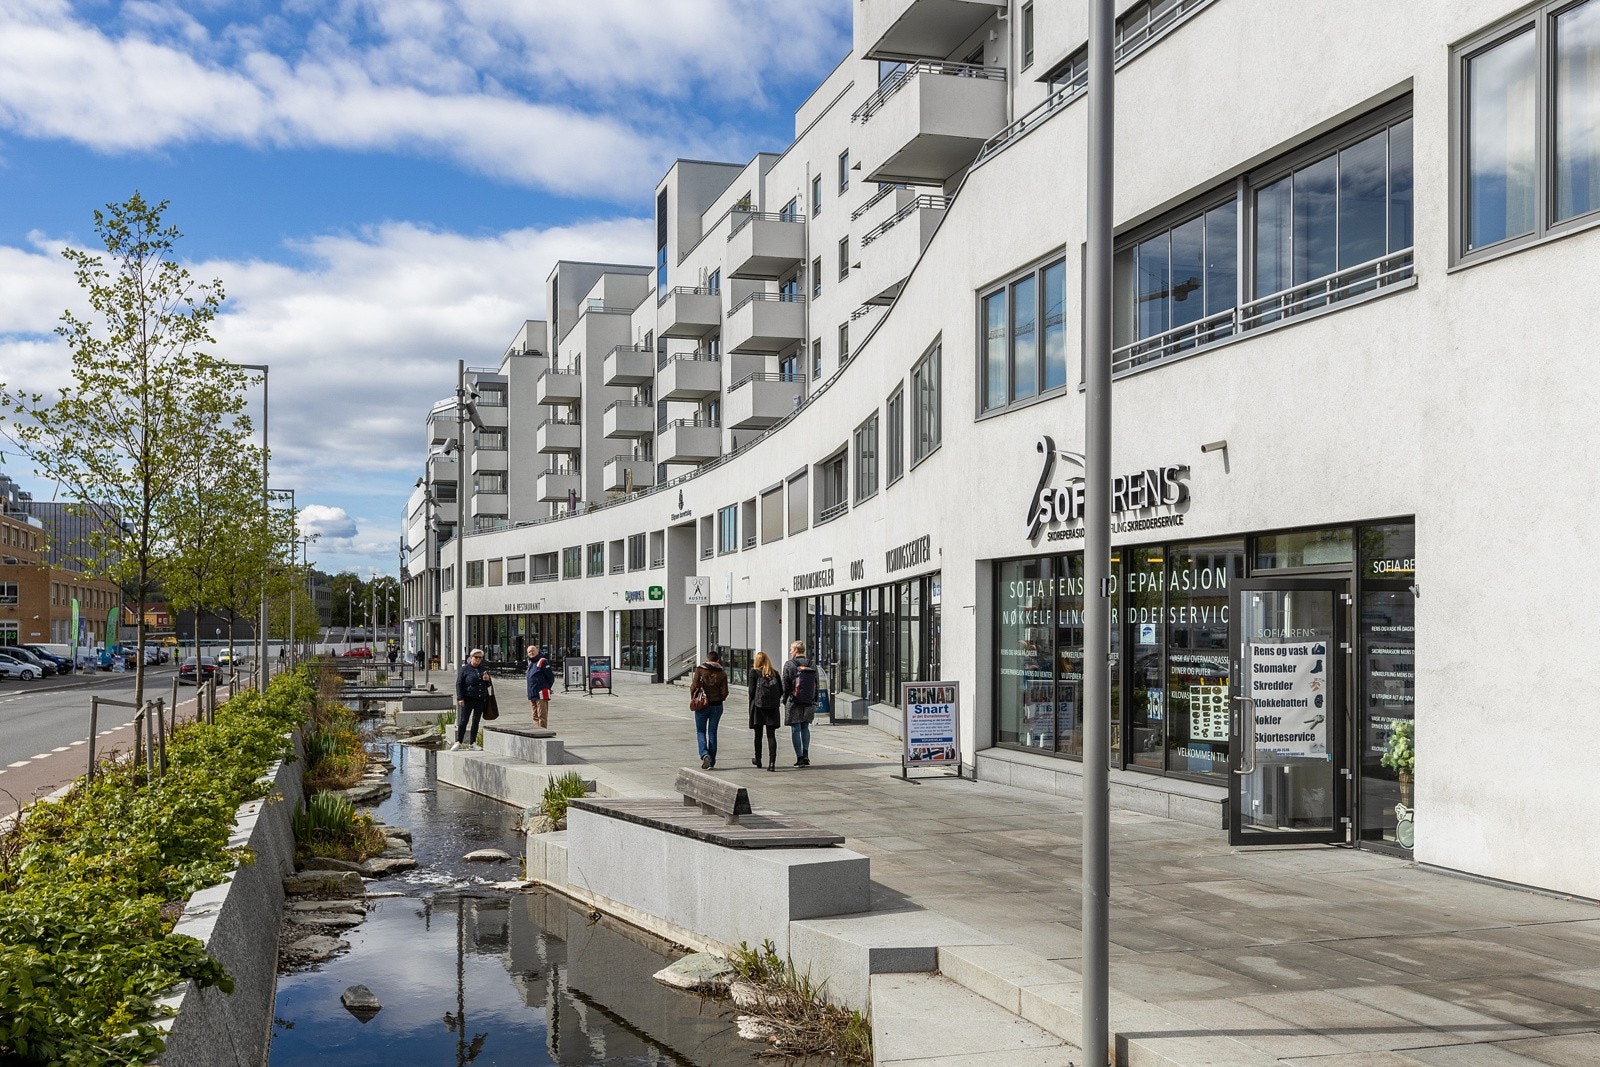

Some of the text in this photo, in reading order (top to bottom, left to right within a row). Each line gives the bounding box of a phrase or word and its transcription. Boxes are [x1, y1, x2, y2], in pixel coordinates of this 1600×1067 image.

[1039, 463, 1190, 523] SOF RENS
[1047, 527, 1085, 542] SKOREPERASJO
[1127, 514, 1184, 532] SKREDDERSERVICE
[885, 533, 931, 573] VISNINGSSENTER
[850, 558, 864, 581] OBOS
[1373, 558, 1415, 574] SOFIA RE
[793, 568, 835, 592] EIENDOMSMEGLER
[1010, 579, 1045, 598] SOFIA
[1291, 628, 1315, 638] RENS
[1253, 646, 1308, 657] Rens og vask
[1195, 668, 1211, 676] PUTER
[1253, 663, 1297, 673] Skomaker
[1253, 680, 1293, 691] Skredder
[908, 687, 955, 704] BUNAD
[1171, 691, 1190, 700] KILOVAS
[914, 704, 949, 714] Snart
[1254, 698, 1308, 708] Klokkebatteri
[1255, 732, 1316, 743] Skjorteservice
[1177, 747, 1215, 761] VELKOMMEN
